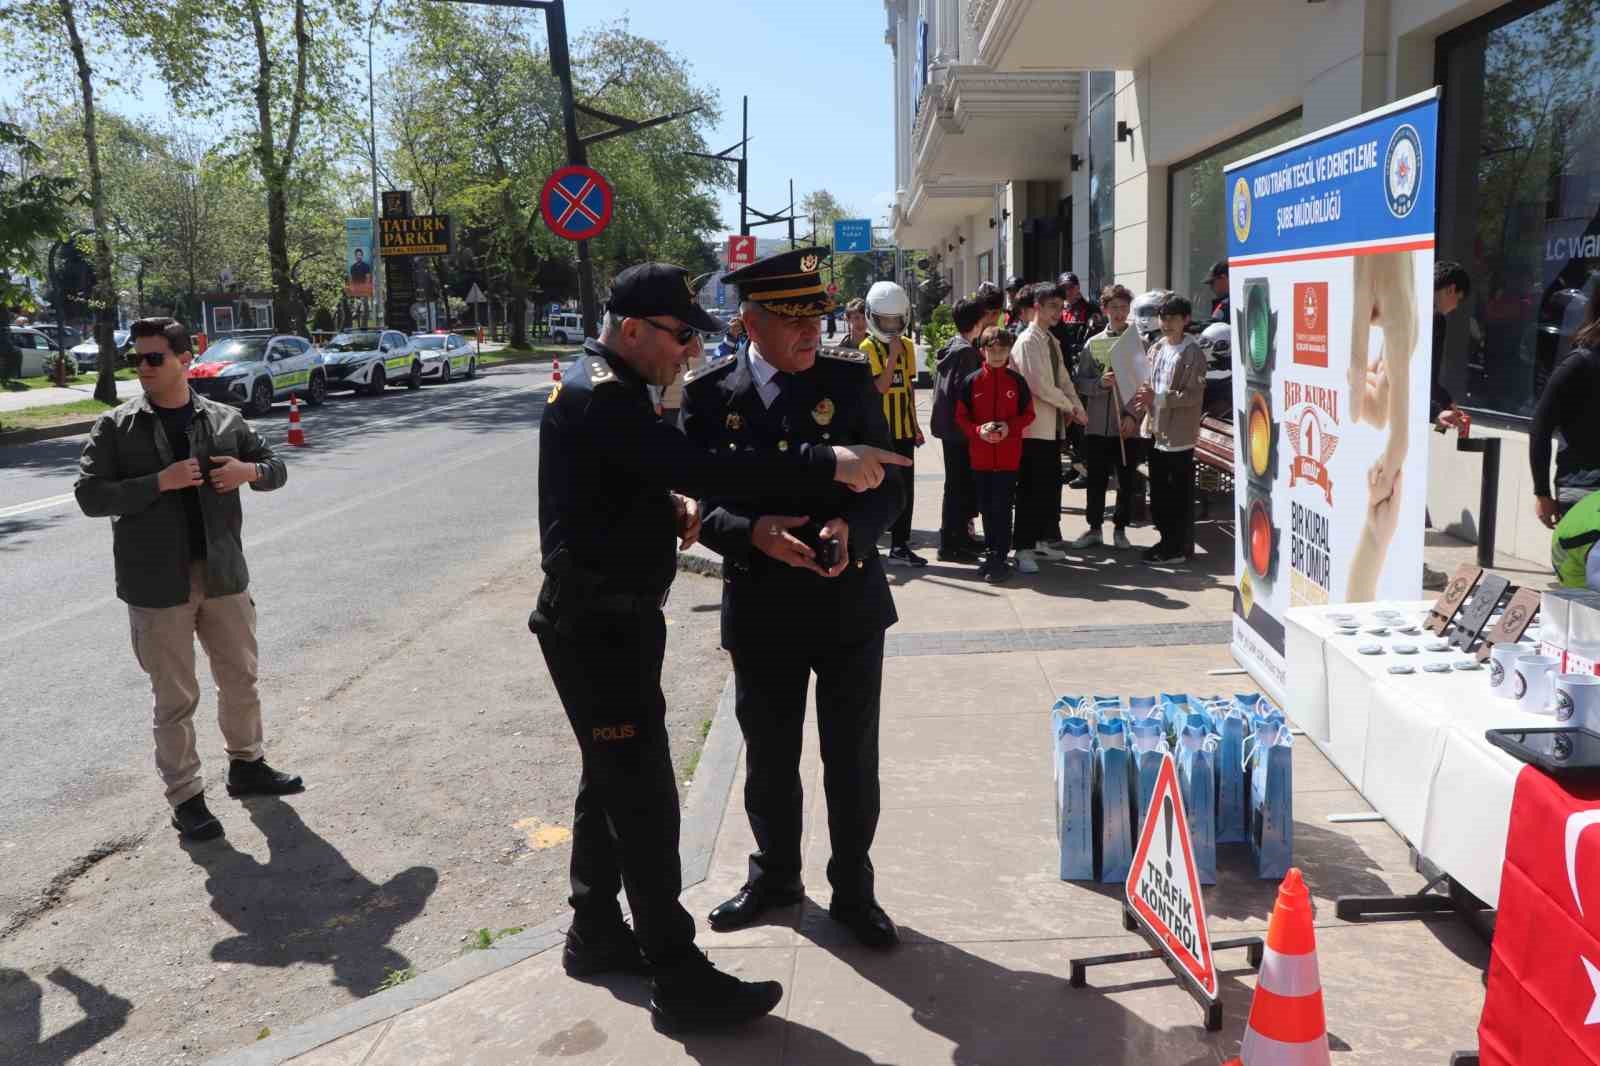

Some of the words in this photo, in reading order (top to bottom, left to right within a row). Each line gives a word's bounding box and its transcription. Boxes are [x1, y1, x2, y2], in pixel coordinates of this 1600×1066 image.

[1316, 157, 1326, 182] VE
[1328, 141, 1378, 179] DENETLEME
[1277, 206, 1293, 236] ŞUBE
[1294, 190, 1341, 226] MÜDÜRLÜĞÜ
[1305, 384, 1339, 426] KURAL
[1305, 507, 1330, 553] KURAL
[1147, 860, 1192, 926] TRAFİK
[1141, 877, 1199, 961] KONTROL
